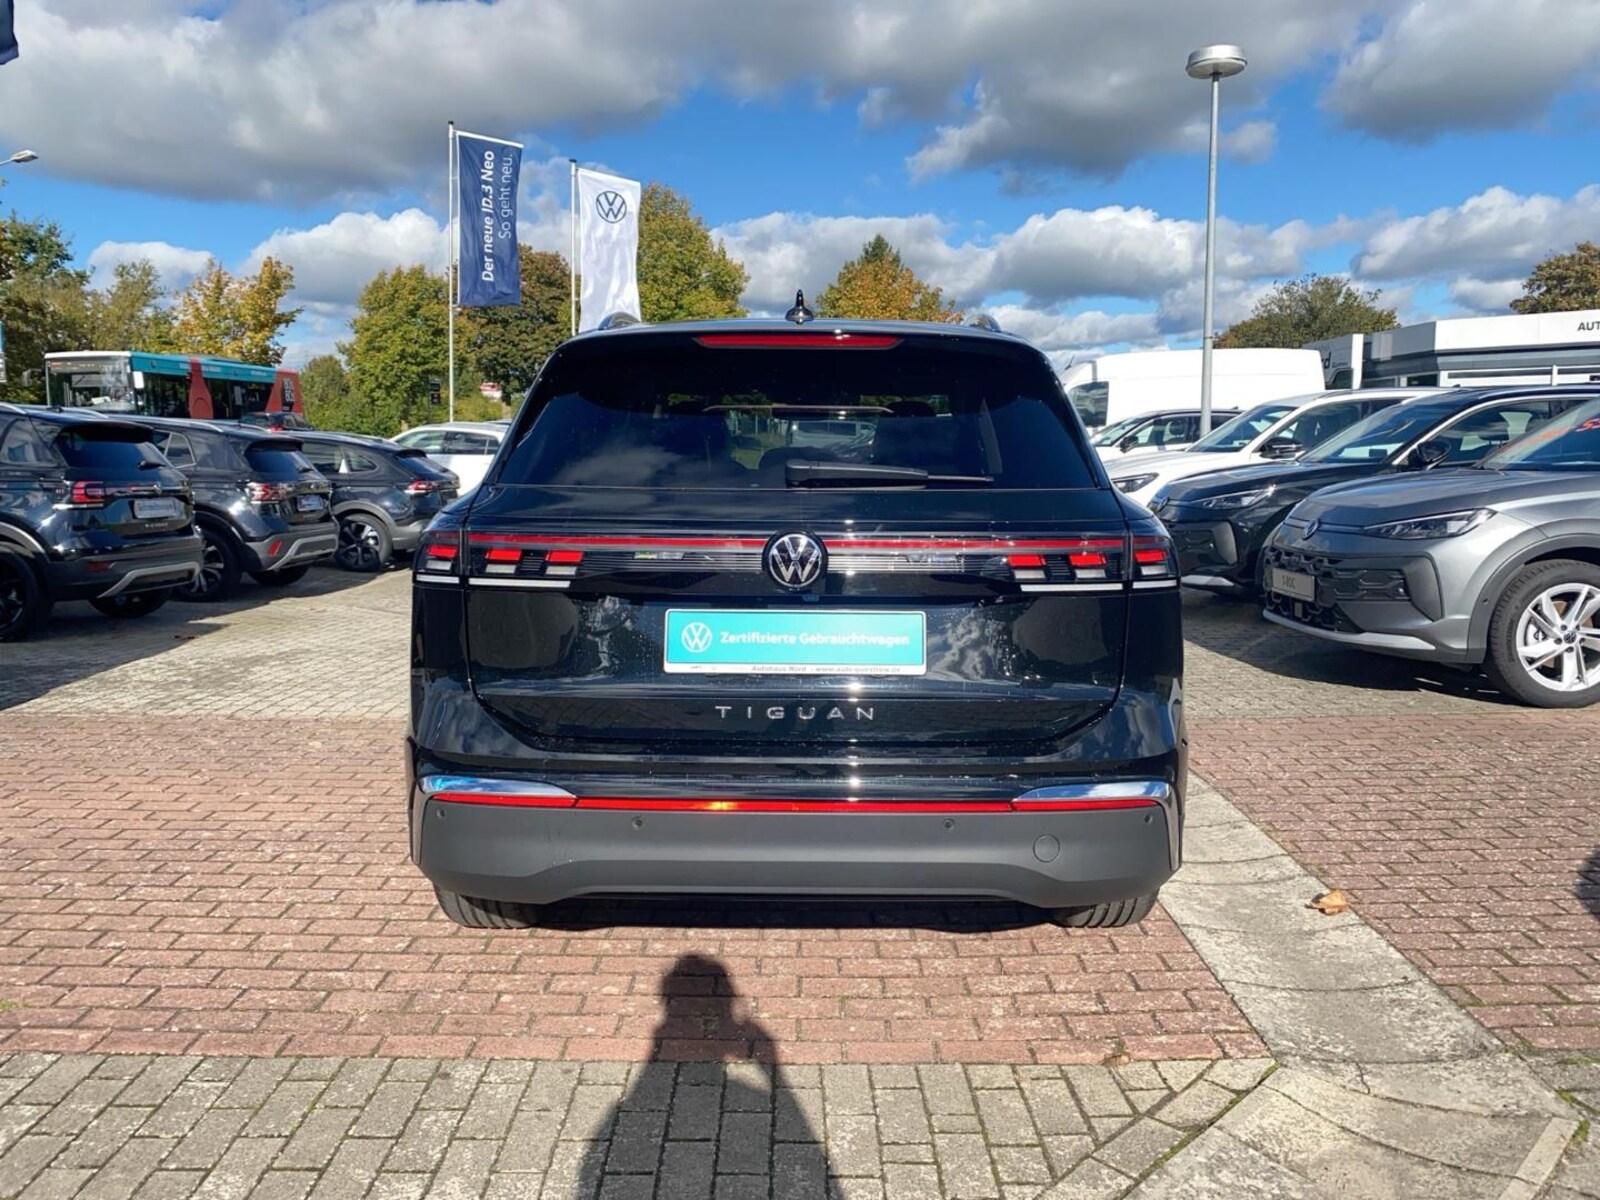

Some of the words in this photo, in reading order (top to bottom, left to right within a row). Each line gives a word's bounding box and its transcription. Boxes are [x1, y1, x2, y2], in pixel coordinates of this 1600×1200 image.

[481, 151, 494, 181] Neo
[501, 153, 513, 183] neu.
[481, 184, 494, 213] ID.3
[499, 184, 513, 219] geht
[483, 216, 494, 252] neue
[499, 221, 511, 239] So
[481, 256, 494, 282] Der
[720, 631, 797, 645] Zertifizierte
[799, 632, 910, 648] Gebrauchtwagen
[714, 705, 875, 720] TIGUAN
